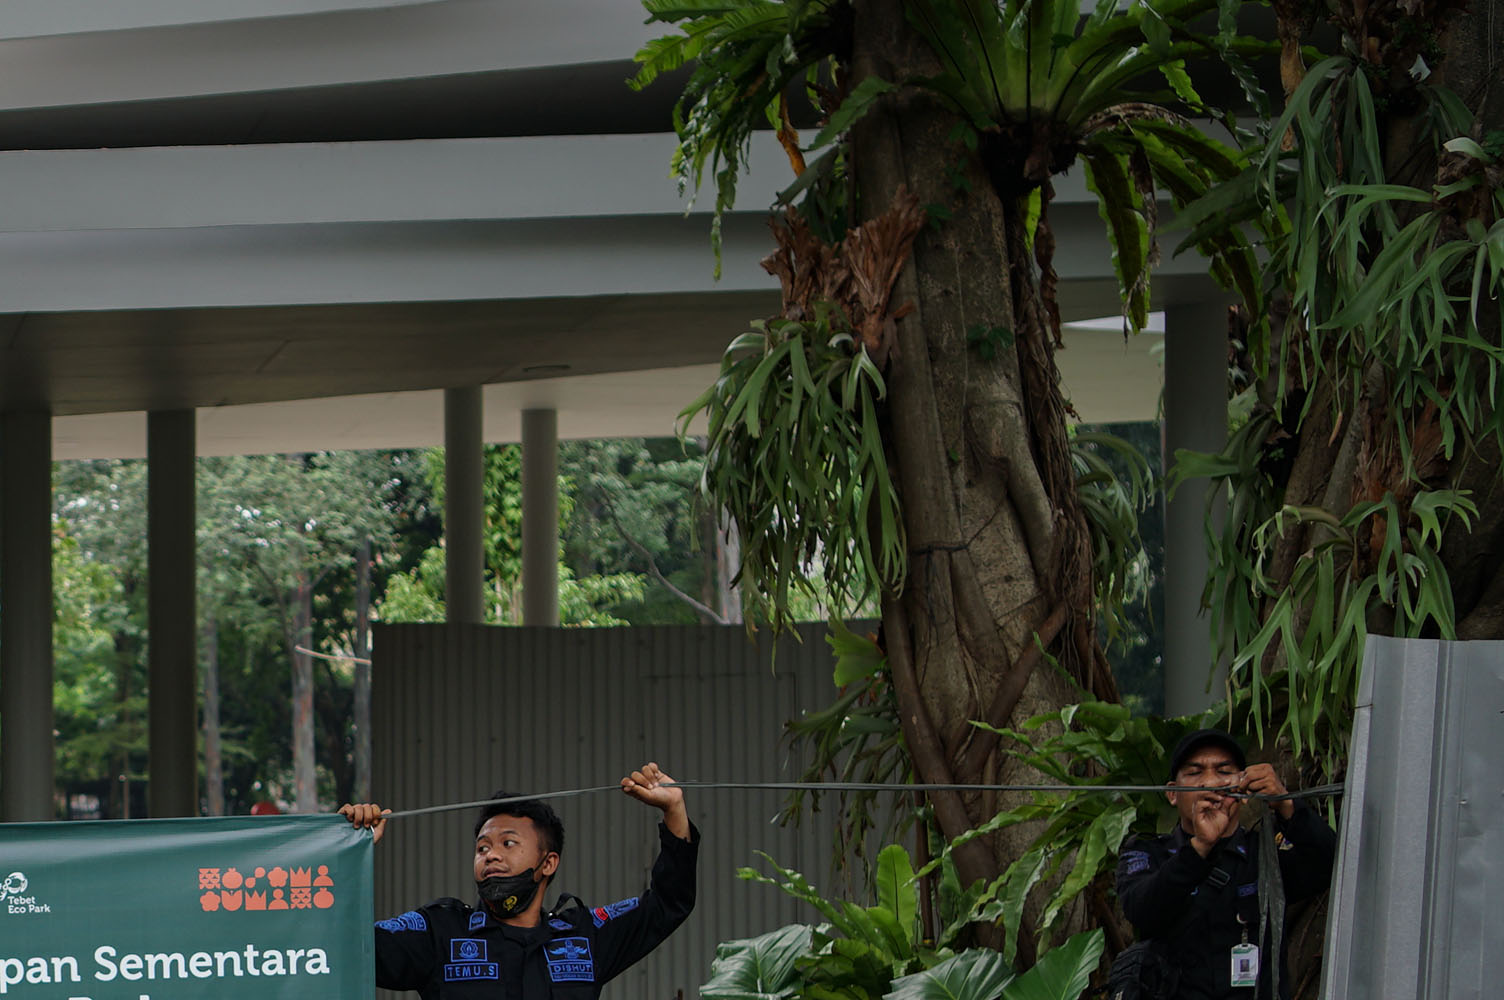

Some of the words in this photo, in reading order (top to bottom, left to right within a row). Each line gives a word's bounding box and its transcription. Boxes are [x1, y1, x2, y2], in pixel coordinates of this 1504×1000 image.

[7, 896, 36, 905] Tebet
[7, 905, 27, 914] Eco
[28, 904, 51, 913] Park
[94, 944, 330, 982] Sementara
